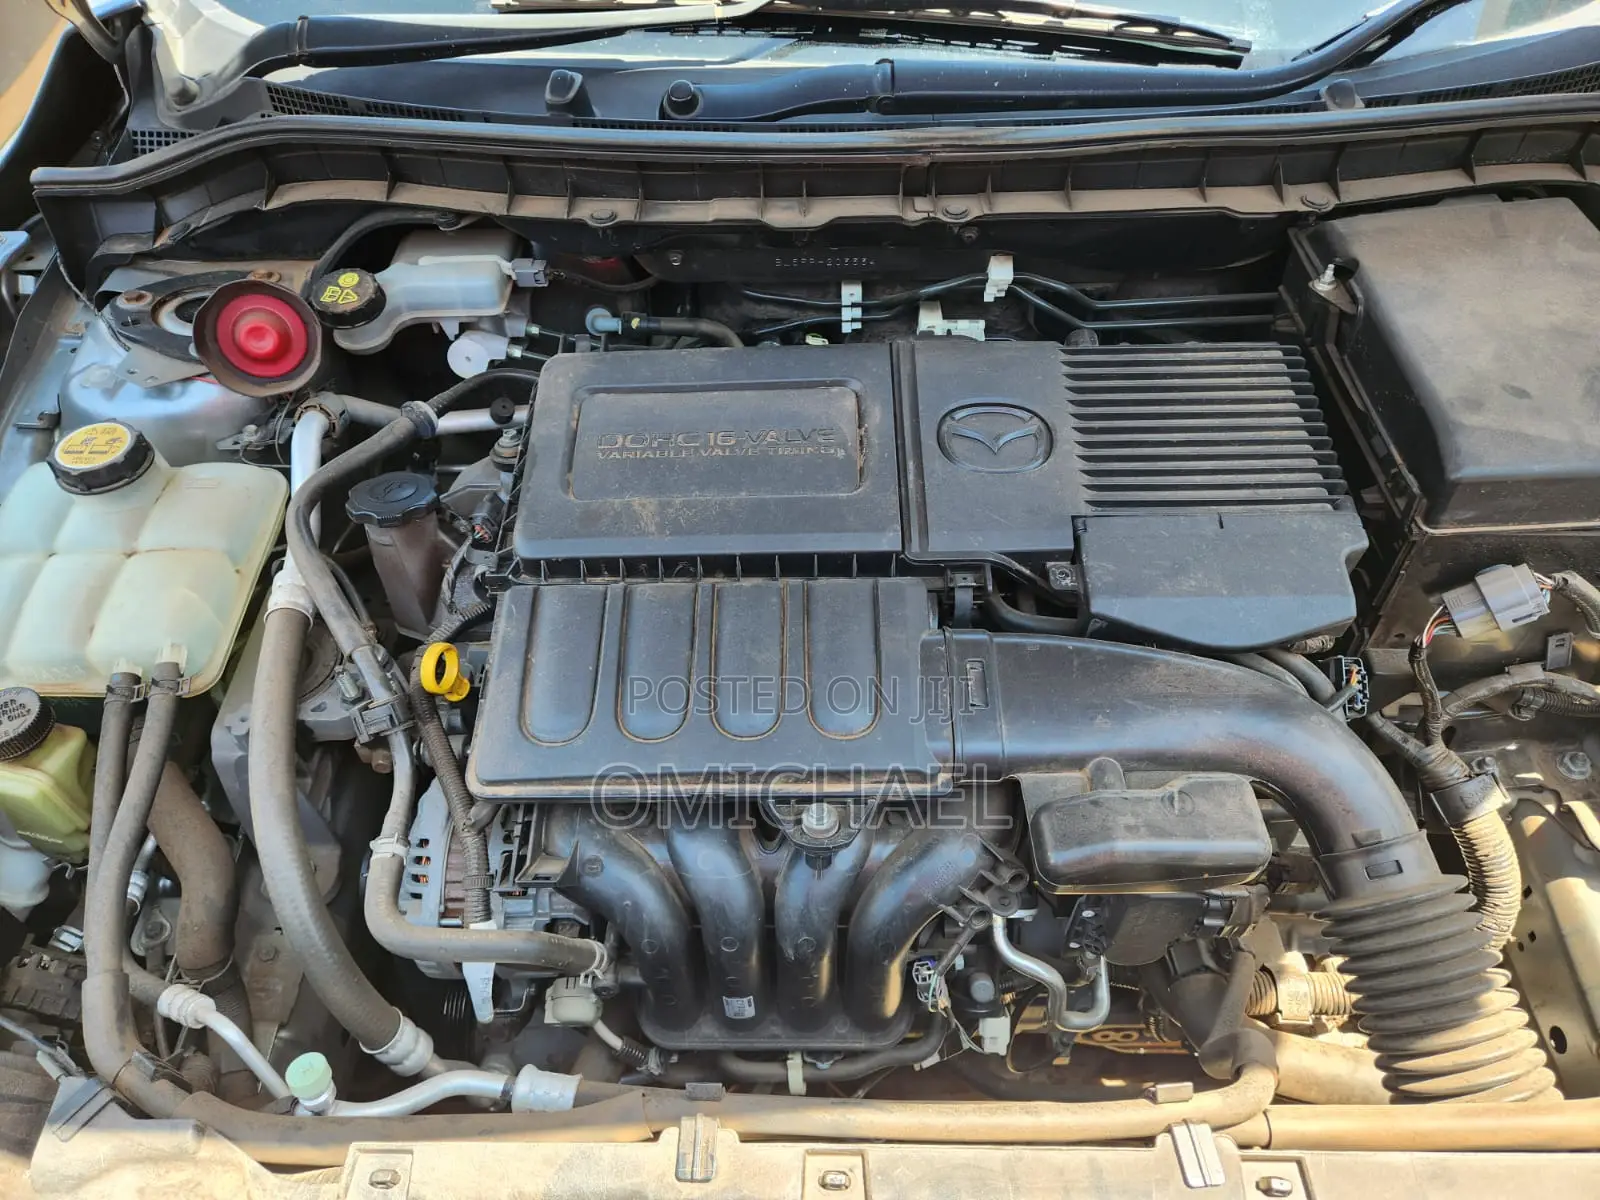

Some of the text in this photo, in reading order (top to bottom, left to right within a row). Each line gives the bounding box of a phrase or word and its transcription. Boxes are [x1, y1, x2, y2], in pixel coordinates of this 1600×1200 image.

[597, 431, 701, 449] DOHC
[597, 448, 695, 460] VARIABLE
[700, 447, 761, 458] VALVE
